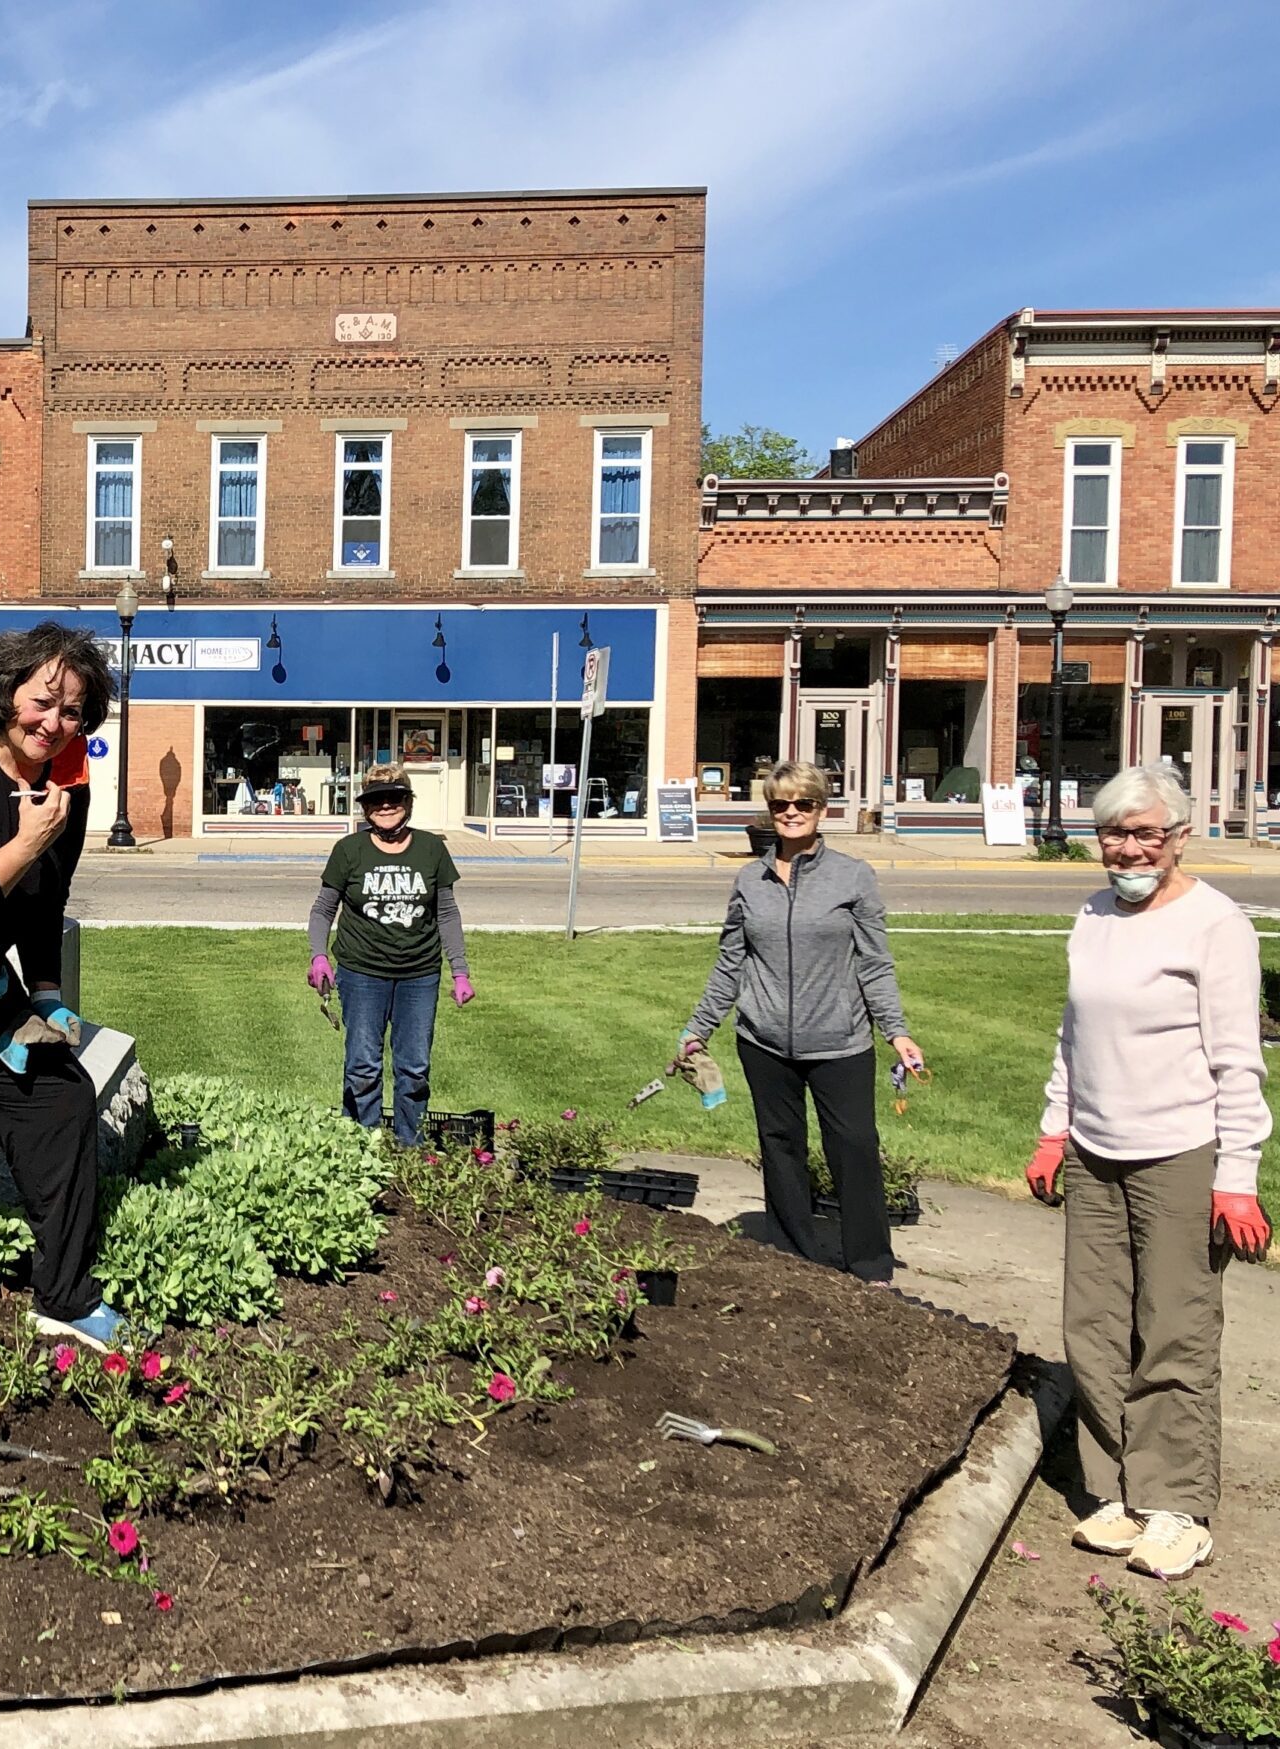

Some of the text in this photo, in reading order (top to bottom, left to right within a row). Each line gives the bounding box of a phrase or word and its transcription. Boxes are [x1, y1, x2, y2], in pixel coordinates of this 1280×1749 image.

[352, 316, 361, 327] &
[102, 642, 189, 665] RMACY
[822, 711, 840, 720] 100
[362, 872, 427, 894] NANA
